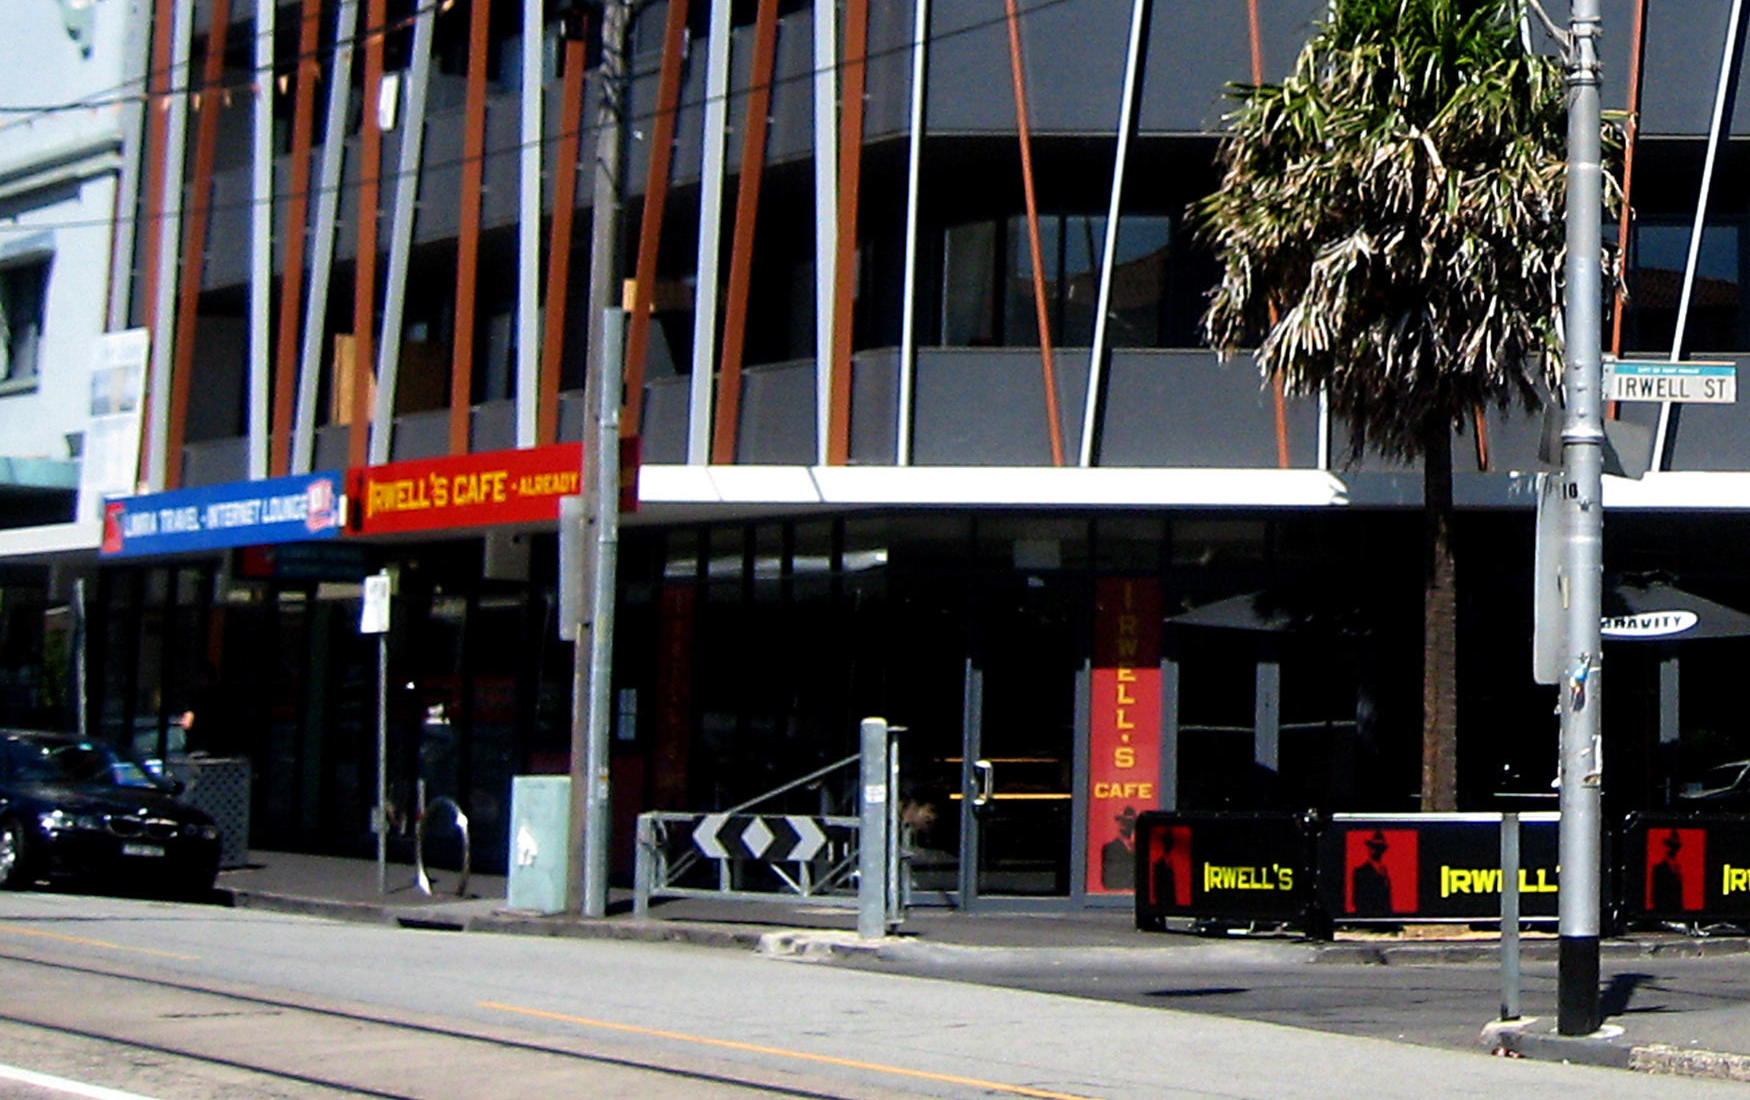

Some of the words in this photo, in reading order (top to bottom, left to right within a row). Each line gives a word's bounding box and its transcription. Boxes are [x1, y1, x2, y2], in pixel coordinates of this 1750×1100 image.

[1618, 377, 1690, 399] IRWELL
[1704, 378, 1726, 399] ST
[367, 472, 448, 518] IRWELL'S
[453, 470, 508, 504] CAFE
[1094, 783, 1152, 799] CAFE
[1204, 862, 1293, 892] IRWELL'S
